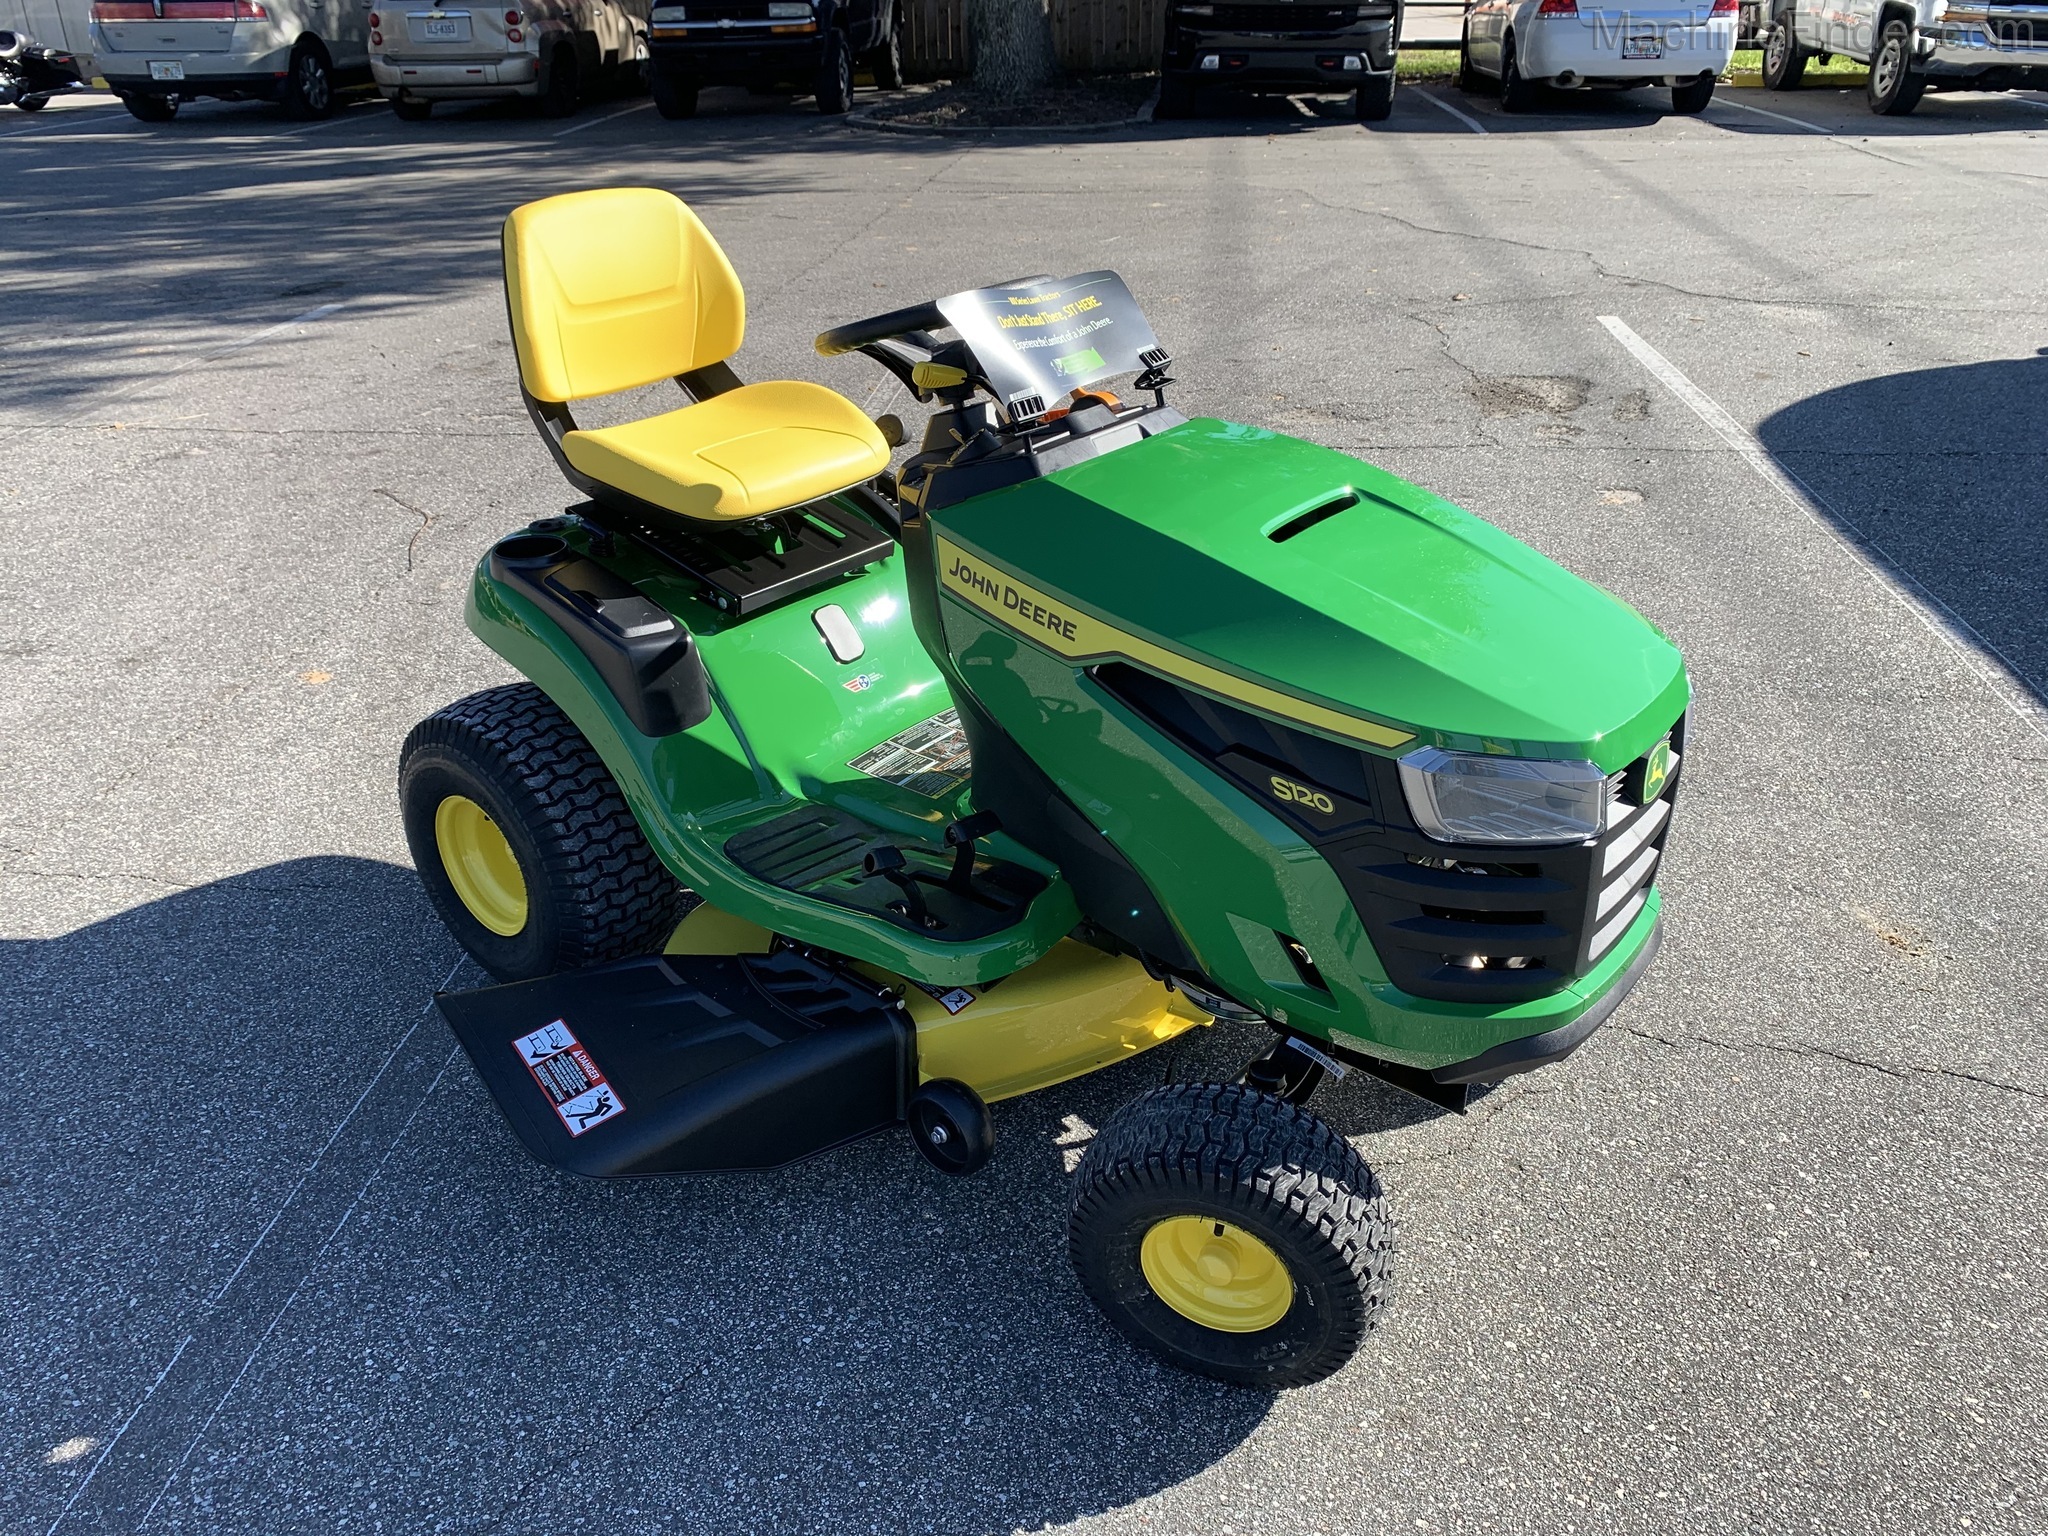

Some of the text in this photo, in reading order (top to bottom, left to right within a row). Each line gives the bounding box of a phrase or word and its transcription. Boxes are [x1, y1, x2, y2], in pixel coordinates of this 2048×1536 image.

[996, 314, 1018, 329] Don't
[1023, 312, 1046, 327] Stand
[1062, 302, 1079, 317] SIT
[1075, 295, 1103, 312] HERE.
[1064, 329, 1073, 341] of
[1075, 323, 1095, 337] John
[1090, 317, 1114, 330] Deere.
[949, 557, 1077, 642] JOHN DEERE
[1270, 776, 1334, 813] S120
[577, 1054, 600, 1080] DANGER
